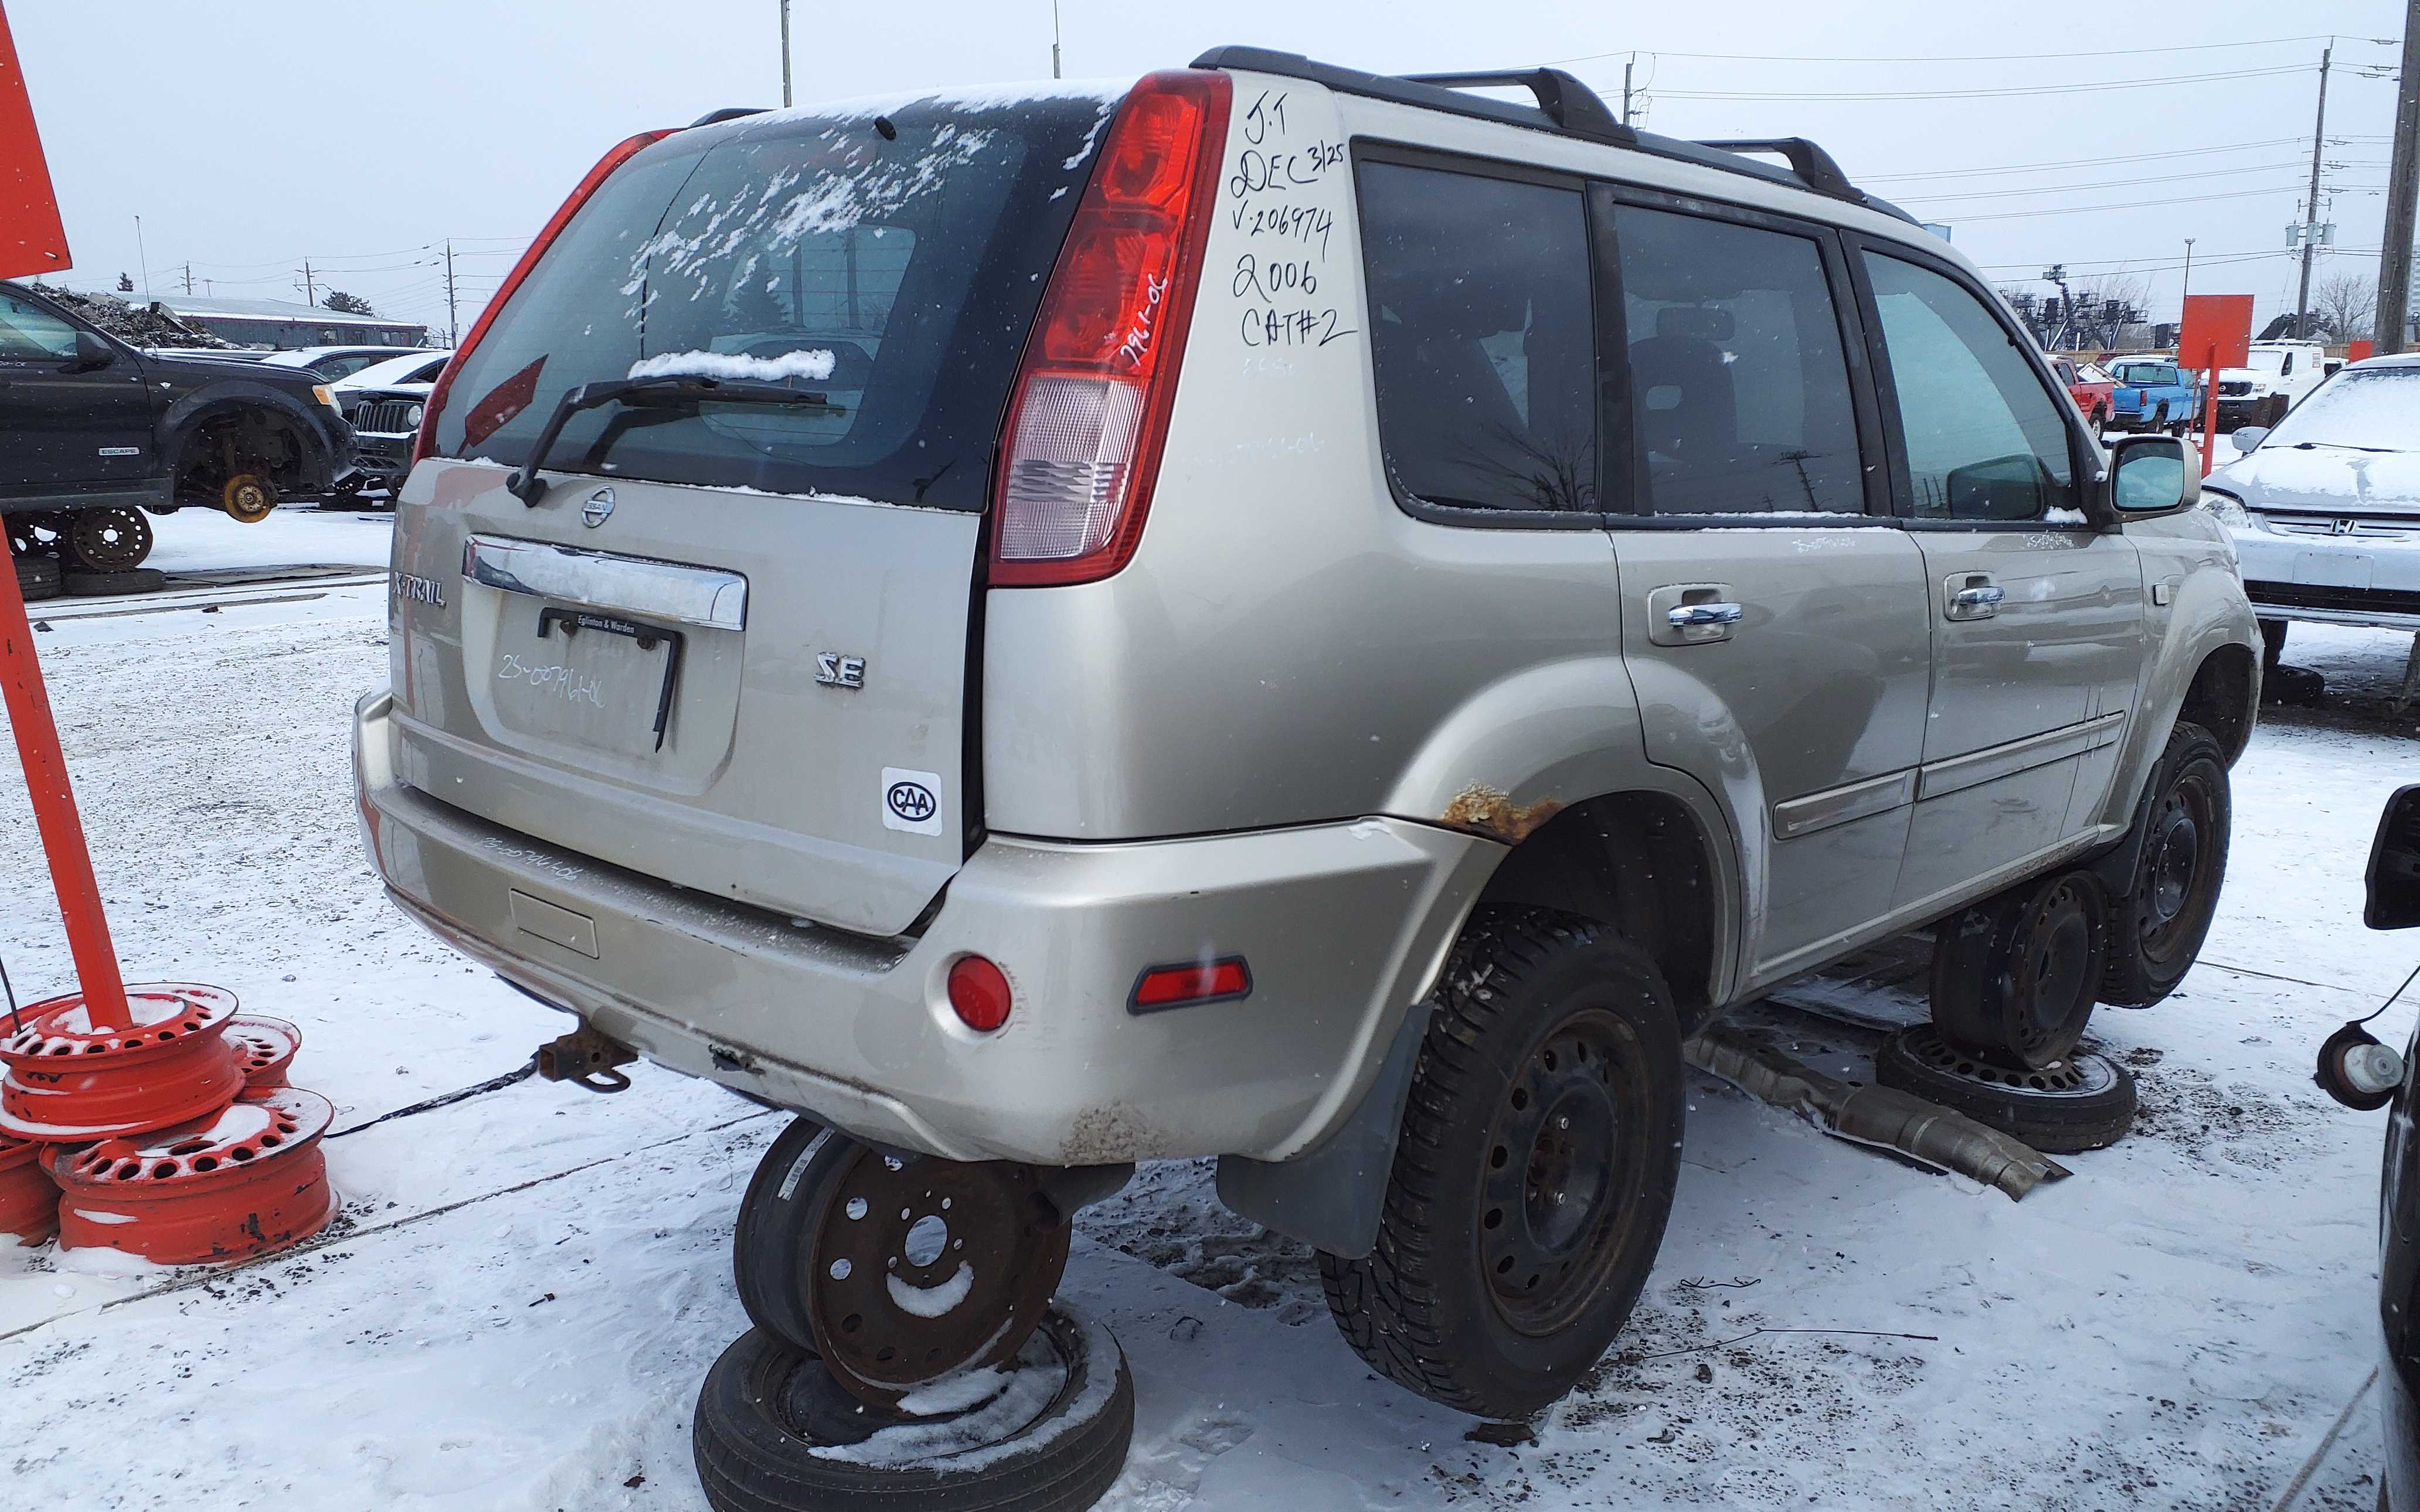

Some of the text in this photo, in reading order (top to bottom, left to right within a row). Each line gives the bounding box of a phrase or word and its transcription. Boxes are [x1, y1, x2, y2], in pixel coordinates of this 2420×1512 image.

[1231, 149, 1319, 198] DEC
[1233, 253, 1317, 304] 2006
[1241, 308, 1359, 347] CAT#2
[393, 571, 447, 607] X-TRAIL
[604, 619, 609, 628] &
[813, 651, 866, 689] SE
[892, 788, 930, 816] CAA
